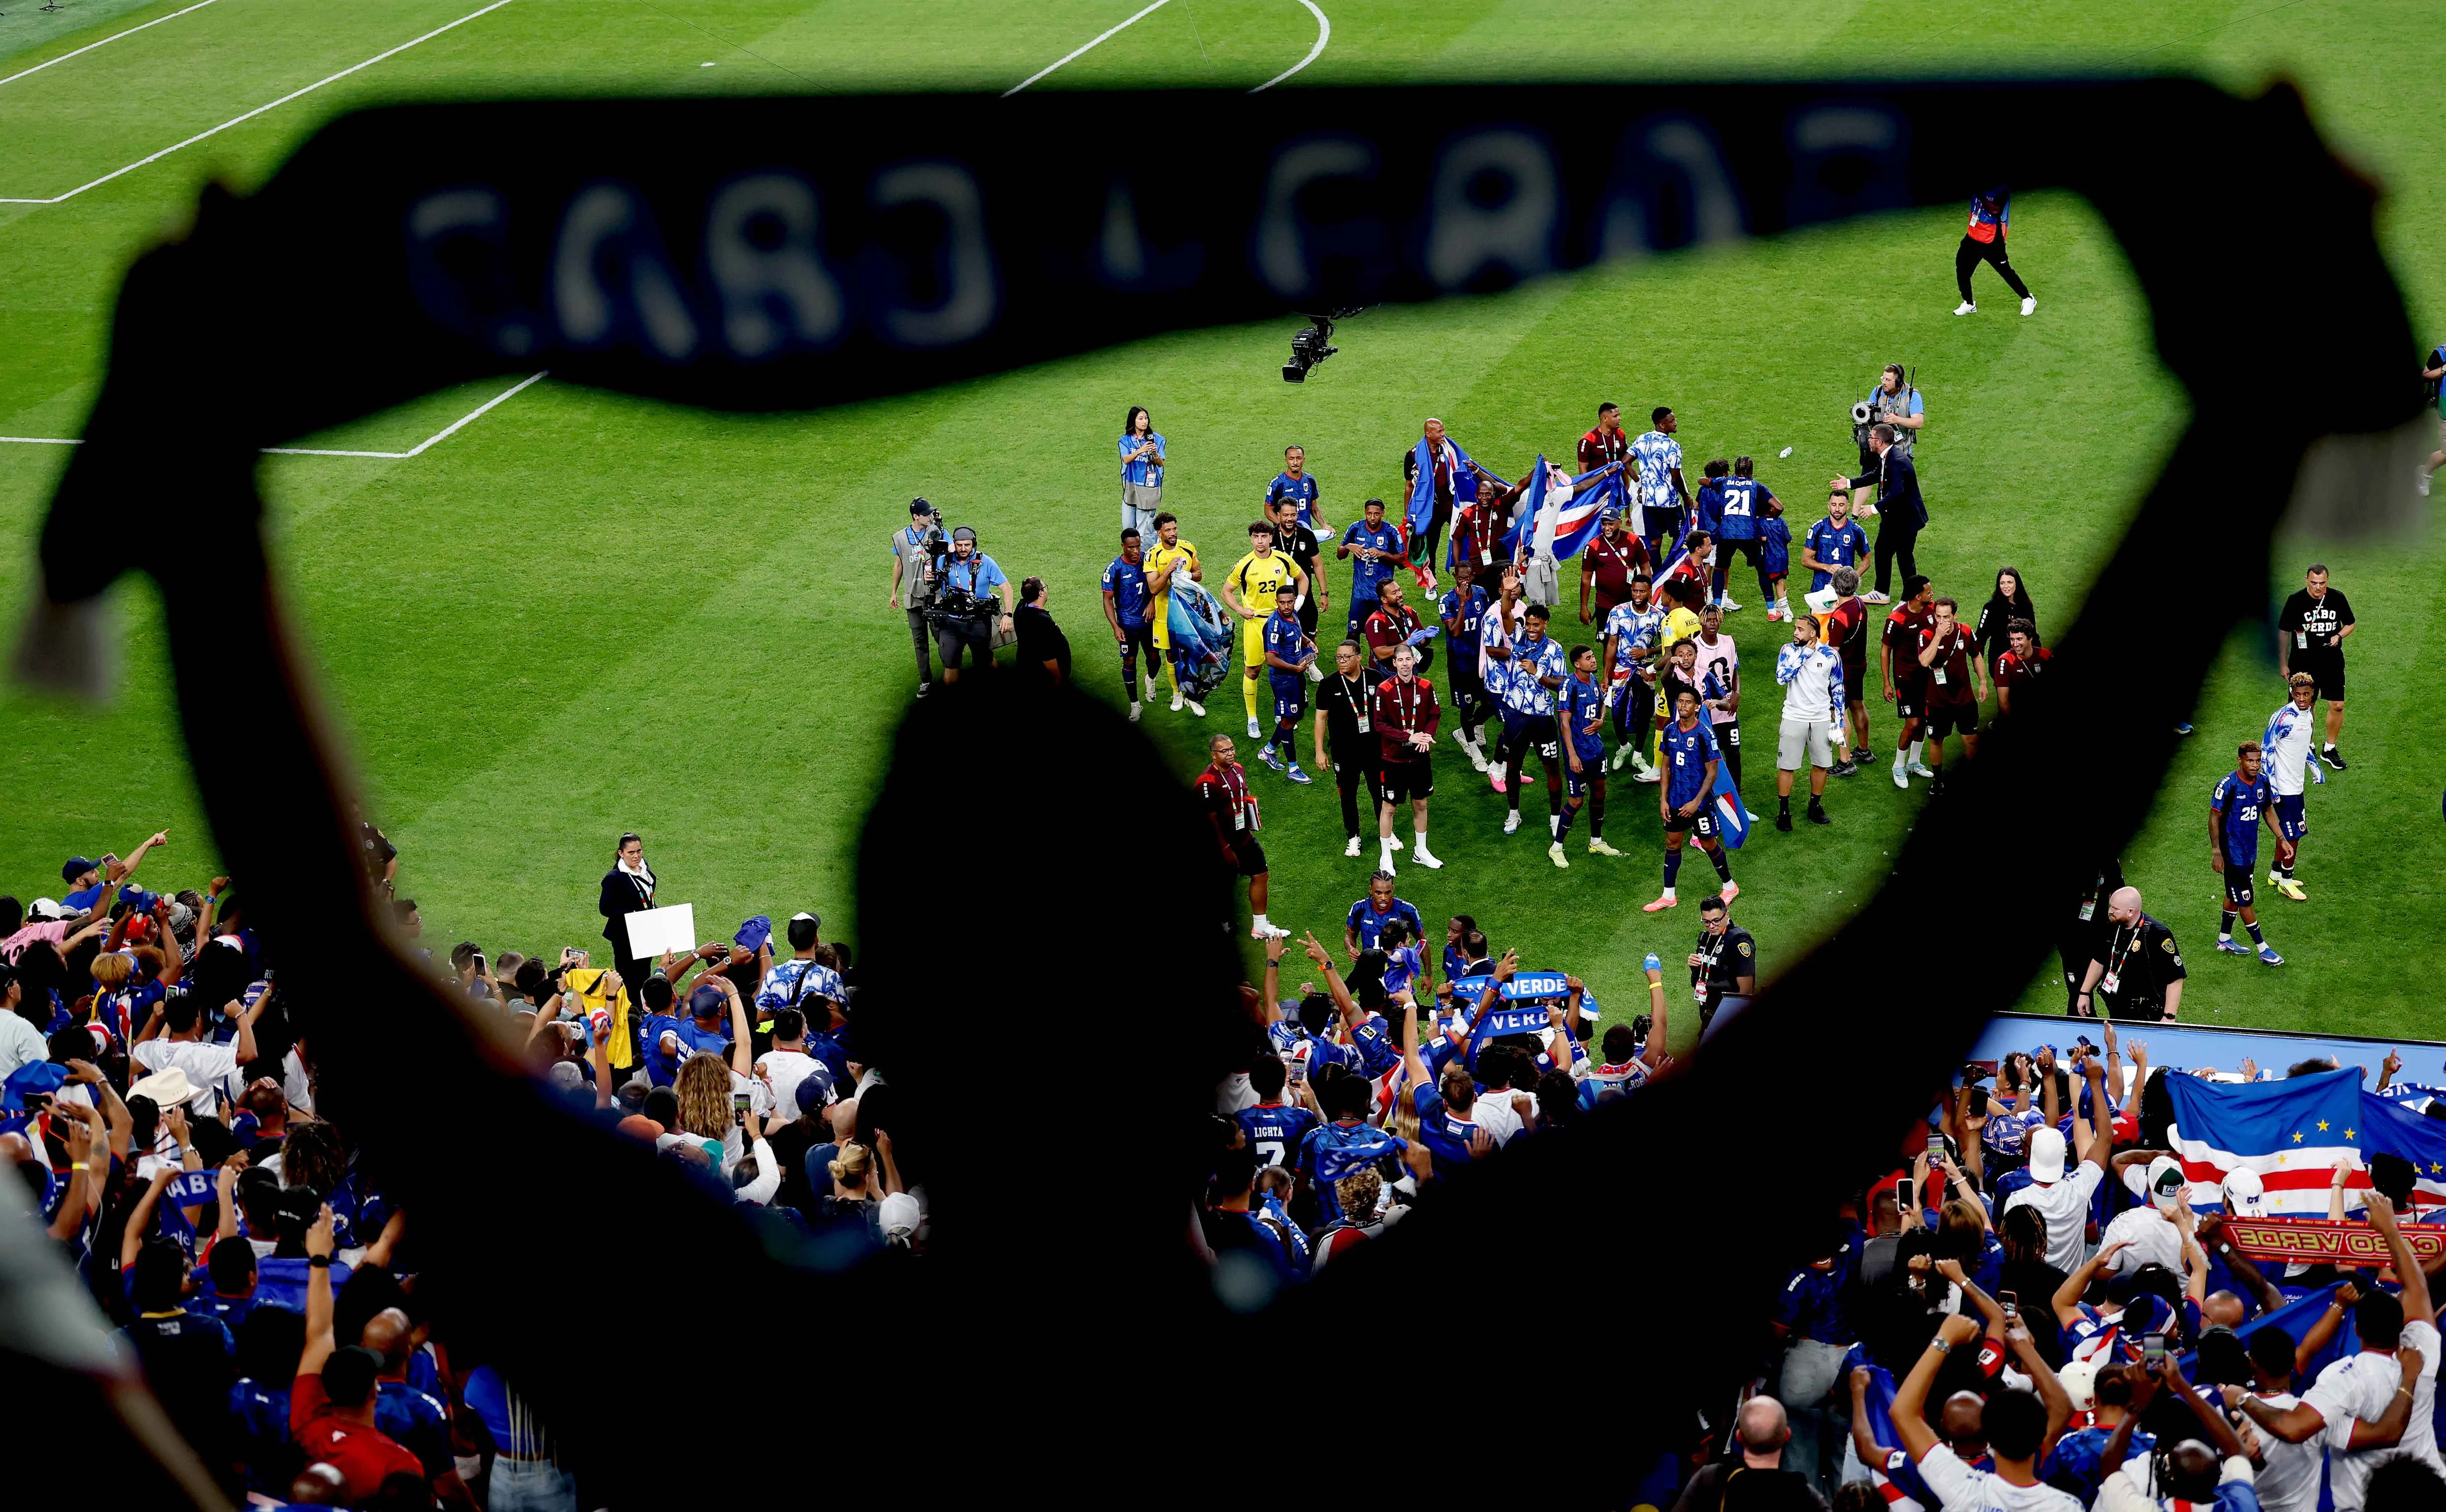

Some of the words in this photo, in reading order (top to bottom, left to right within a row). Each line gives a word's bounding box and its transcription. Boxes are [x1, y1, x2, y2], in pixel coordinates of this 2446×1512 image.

[1724, 489, 1751, 516] 21
[1831, 547, 1840, 560] 4
[1136, 582, 1143, 595] 7
[1258, 580, 1276, 593] 23
[1464, 617, 1477, 631] 17
[1585, 703, 1596, 719] 15
[1730, 728, 1739, 742] 9
[1541, 741, 1557, 756] 25
[1676, 751, 1685, 766] 6
[2239, 805, 2257, 821] 26
[1698, 817, 1710, 831] 6
[1374, 935, 1383, 950] 1
[1507, 978, 1567, 995] VERDE
[1491, 1012, 1550, 1030] VERD
[1254, 1126, 1284, 1138] LIGHTA
[1256, 1141, 1286, 1166] 7
[166, 1173, 220, 1198] AB
